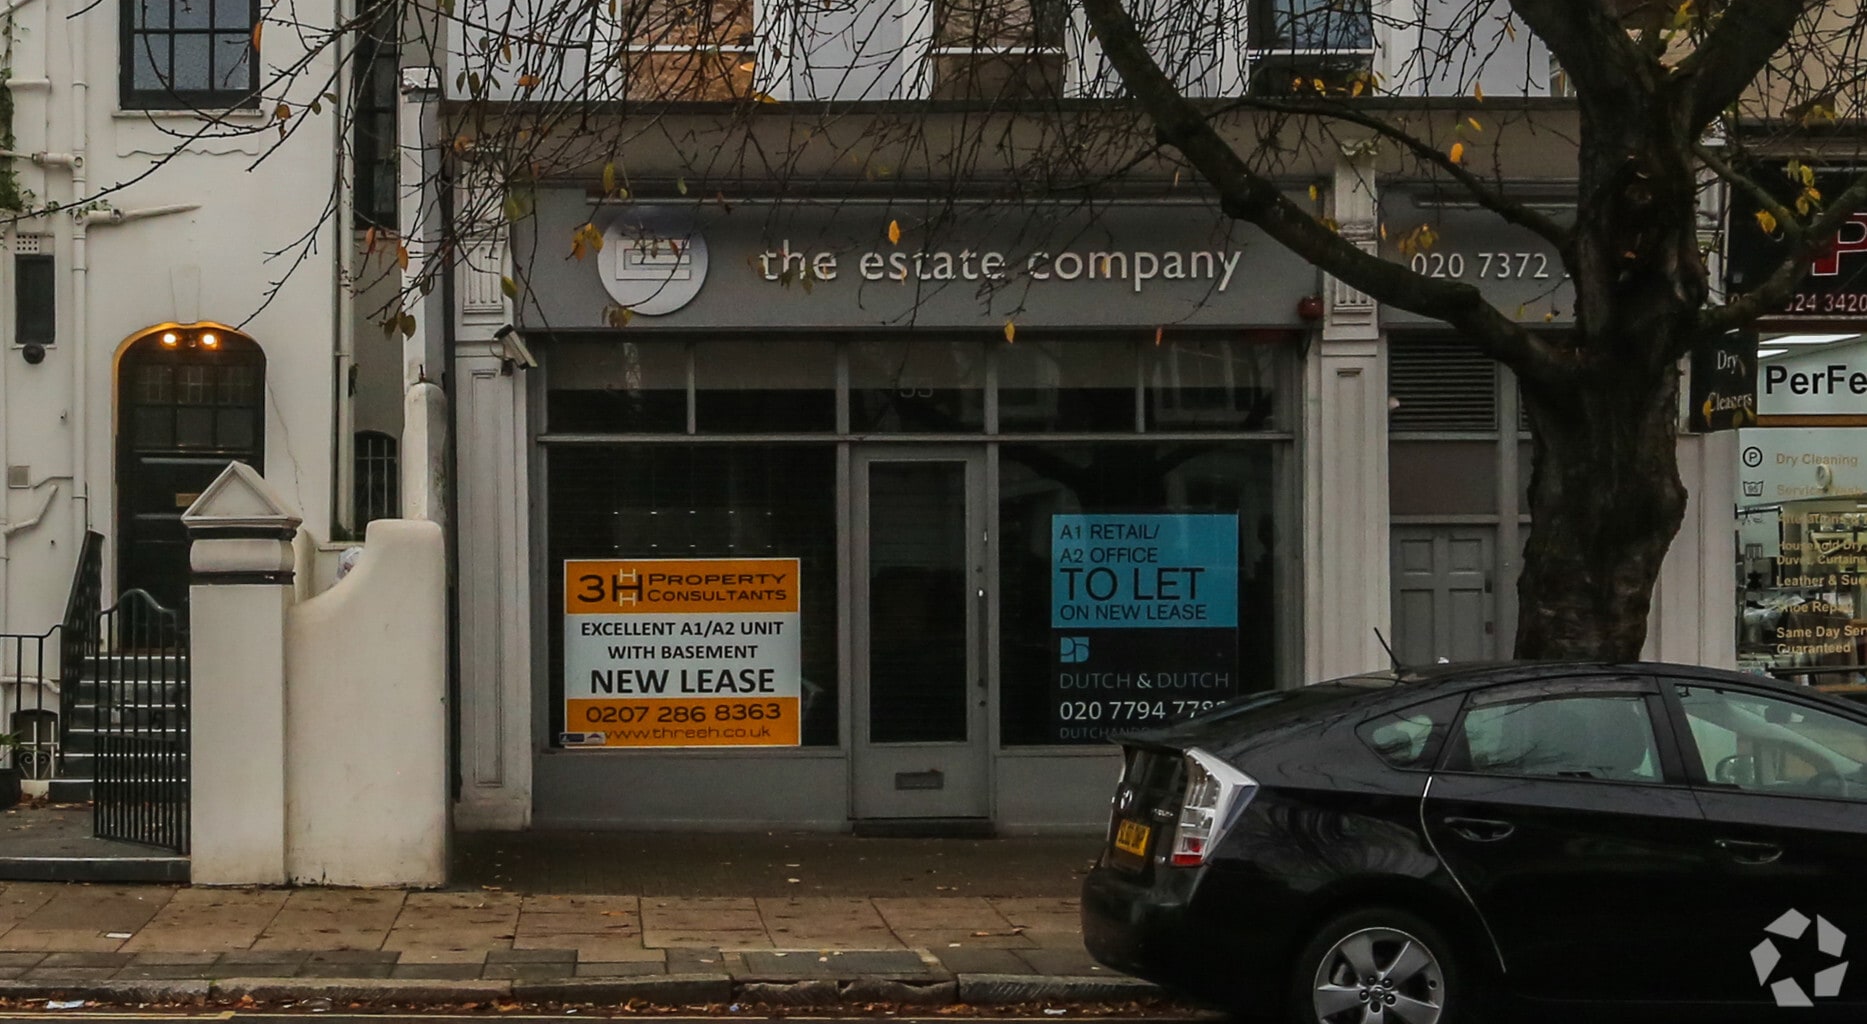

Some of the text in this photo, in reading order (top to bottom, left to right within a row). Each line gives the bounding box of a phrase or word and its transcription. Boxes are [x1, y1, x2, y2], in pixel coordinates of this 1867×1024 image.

[758, 240, 1242, 291] the estate company
[1410, 252, 1549, 278] 020 7372
[1716, 350, 1738, 374] Dry
[1776, 453, 1859, 467] Dry Cleaning
[1060, 524, 1082, 540] A1
[1060, 547, 1159, 564] A2 OFFICE
[648, 574, 787, 586] PROPERTY
[1059, 567, 1206, 602] TO LET
[1776, 575, 1825, 587] Leather
[646, 589, 788, 603] CONSULTANTS
[1060, 604, 1207, 621] ON NEW LEASE
[581, 621, 784, 637] EXCELLENT A1/A2 UNIT
[1776, 627, 1812, 638] Same
[1816, 626, 1840, 640] Day
[608, 645, 758, 659] WITH BASEMENT
[1776, 641, 1851, 654] Guaranteed
[591, 669, 775, 694] NEW LEASE
[1060, 673, 1229, 689] DUTCH & DUTCH
[586, 703, 781, 723] 0207 286 8363
[1060, 701, 1102, 720] 020
[1109, 701, 1166, 720] 7794
